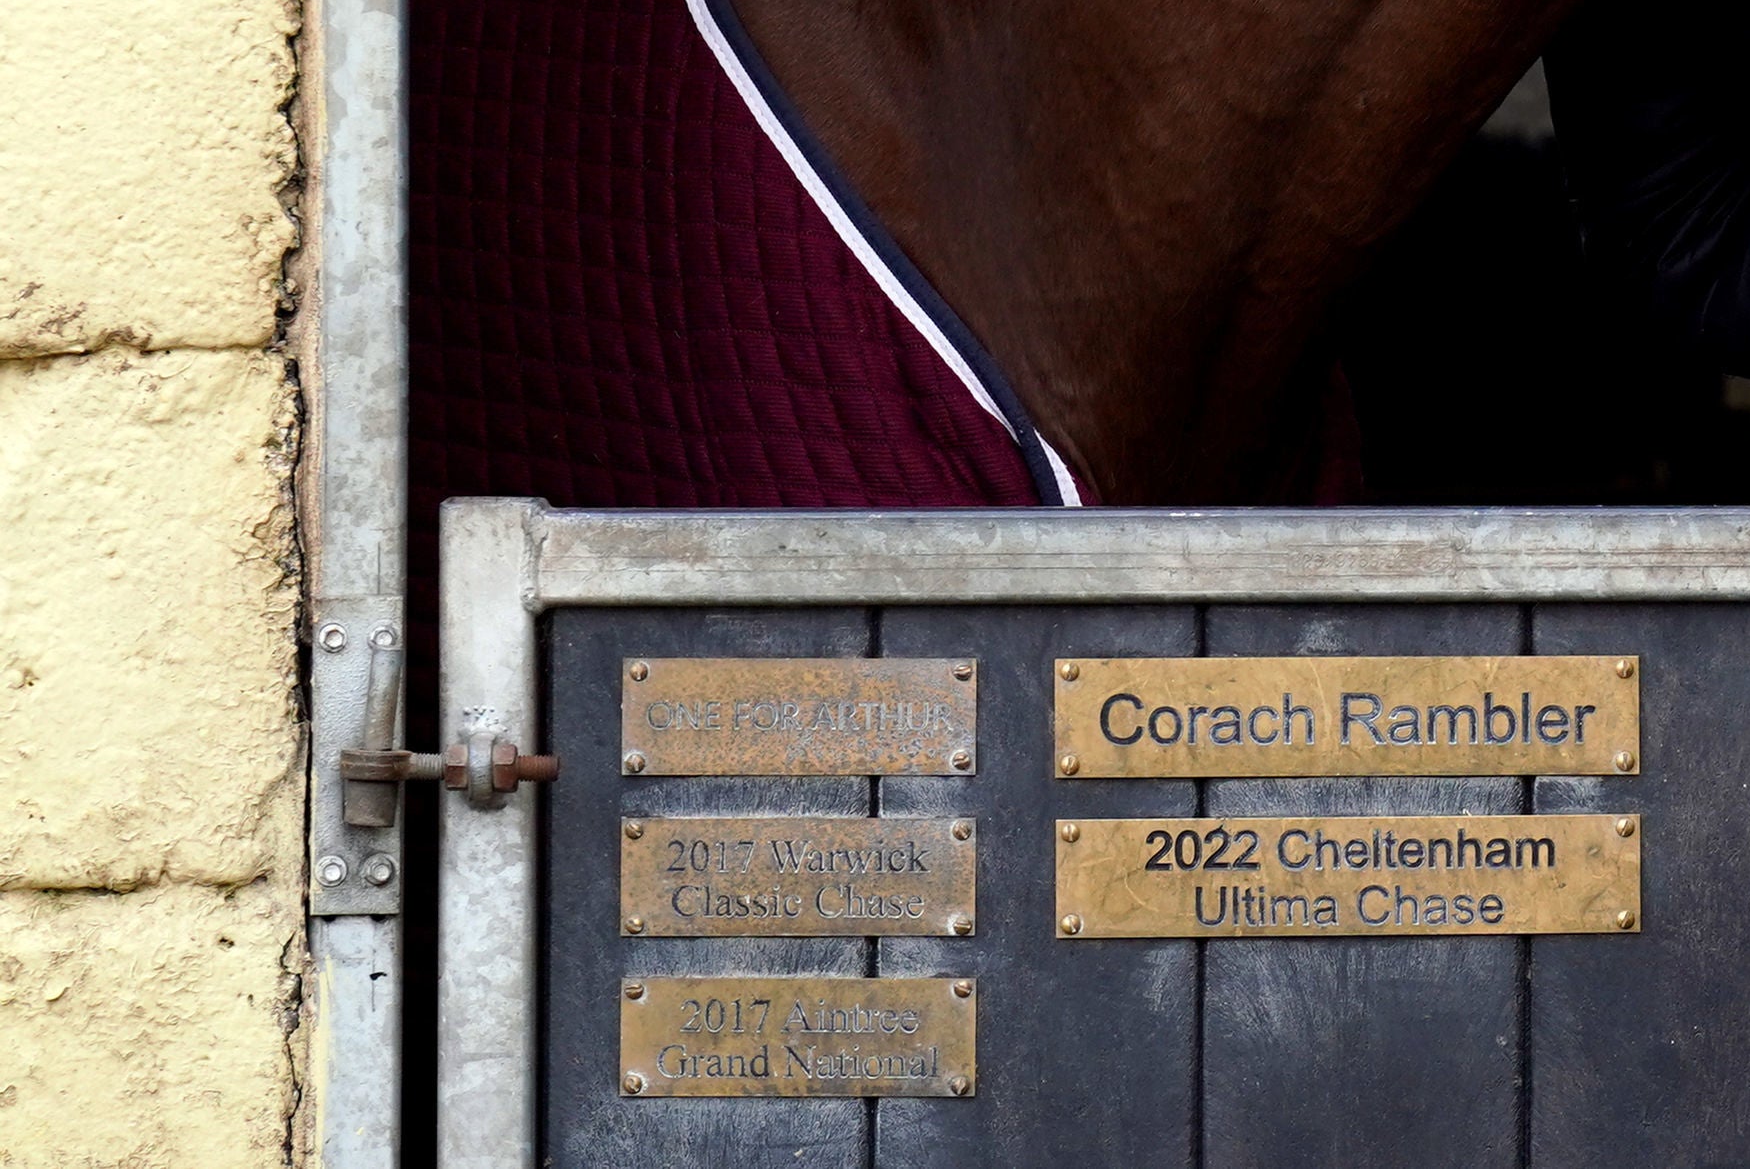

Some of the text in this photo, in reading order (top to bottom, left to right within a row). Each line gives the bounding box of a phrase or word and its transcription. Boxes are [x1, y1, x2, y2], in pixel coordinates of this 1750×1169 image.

[646, 701, 954, 731] ONE FOR ARTHUR
[1100, 691, 1596, 746] Corach Rambler
[666, 839, 930, 873] 2017 Warwick
[1145, 828, 1555, 871] 2022 Cheltenham
[671, 884, 925, 918] Classic Chase
[1195, 884, 1505, 927] Ultima Chase
[680, 999, 921, 1033] 2017 Aintree
[656, 1044, 940, 1079] Grand National
